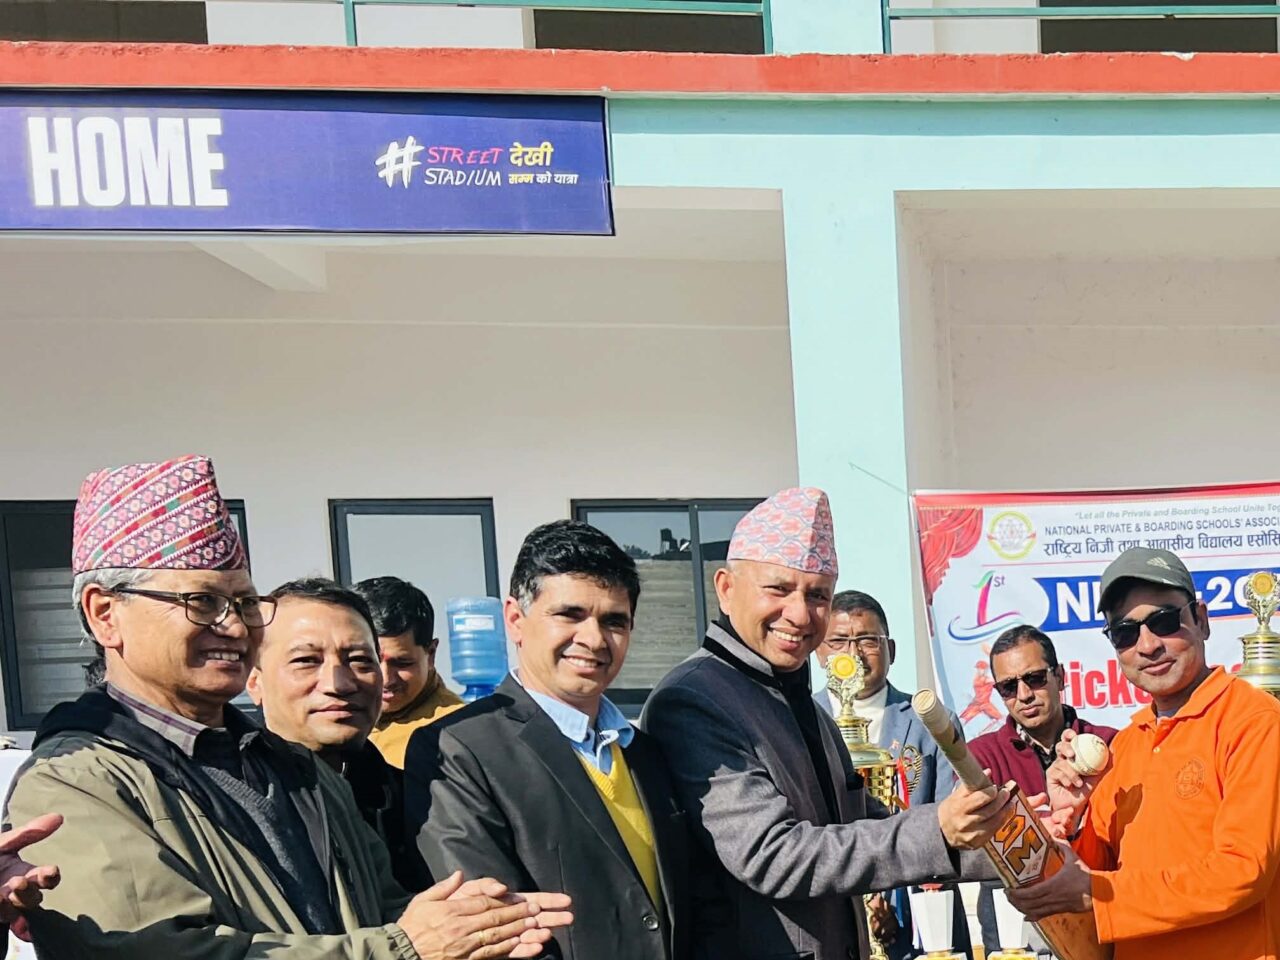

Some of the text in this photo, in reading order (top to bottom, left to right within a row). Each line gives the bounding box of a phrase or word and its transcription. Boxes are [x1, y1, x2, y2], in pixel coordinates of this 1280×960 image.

[27, 116, 229, 206] HOME
[427, 146, 504, 165] STREET
[509, 142, 554, 167] देखी
[425, 167, 501, 186] STADIUM
[536, 171, 552, 184] को
[554, 174, 579, 185] यात्रा
[1107, 510, 1120, 518] the
[1122, 509, 1151, 518] Private
[1153, 508, 1170, 516] and
[1172, 506, 1209, 516] Boarding
[1212, 504, 1241, 514] School
[1243, 503, 1265, 512] Unite
[1045, 524, 1092, 536] NATIONAL
[1094, 523, 1132, 534] PRIVATE
[1135, 522, 1142, 532] &
[1144, 520, 1193, 532] BOARDING
[1085, 537, 1114, 554] निजी
[1198, 532, 1243, 549] विद्यालय
